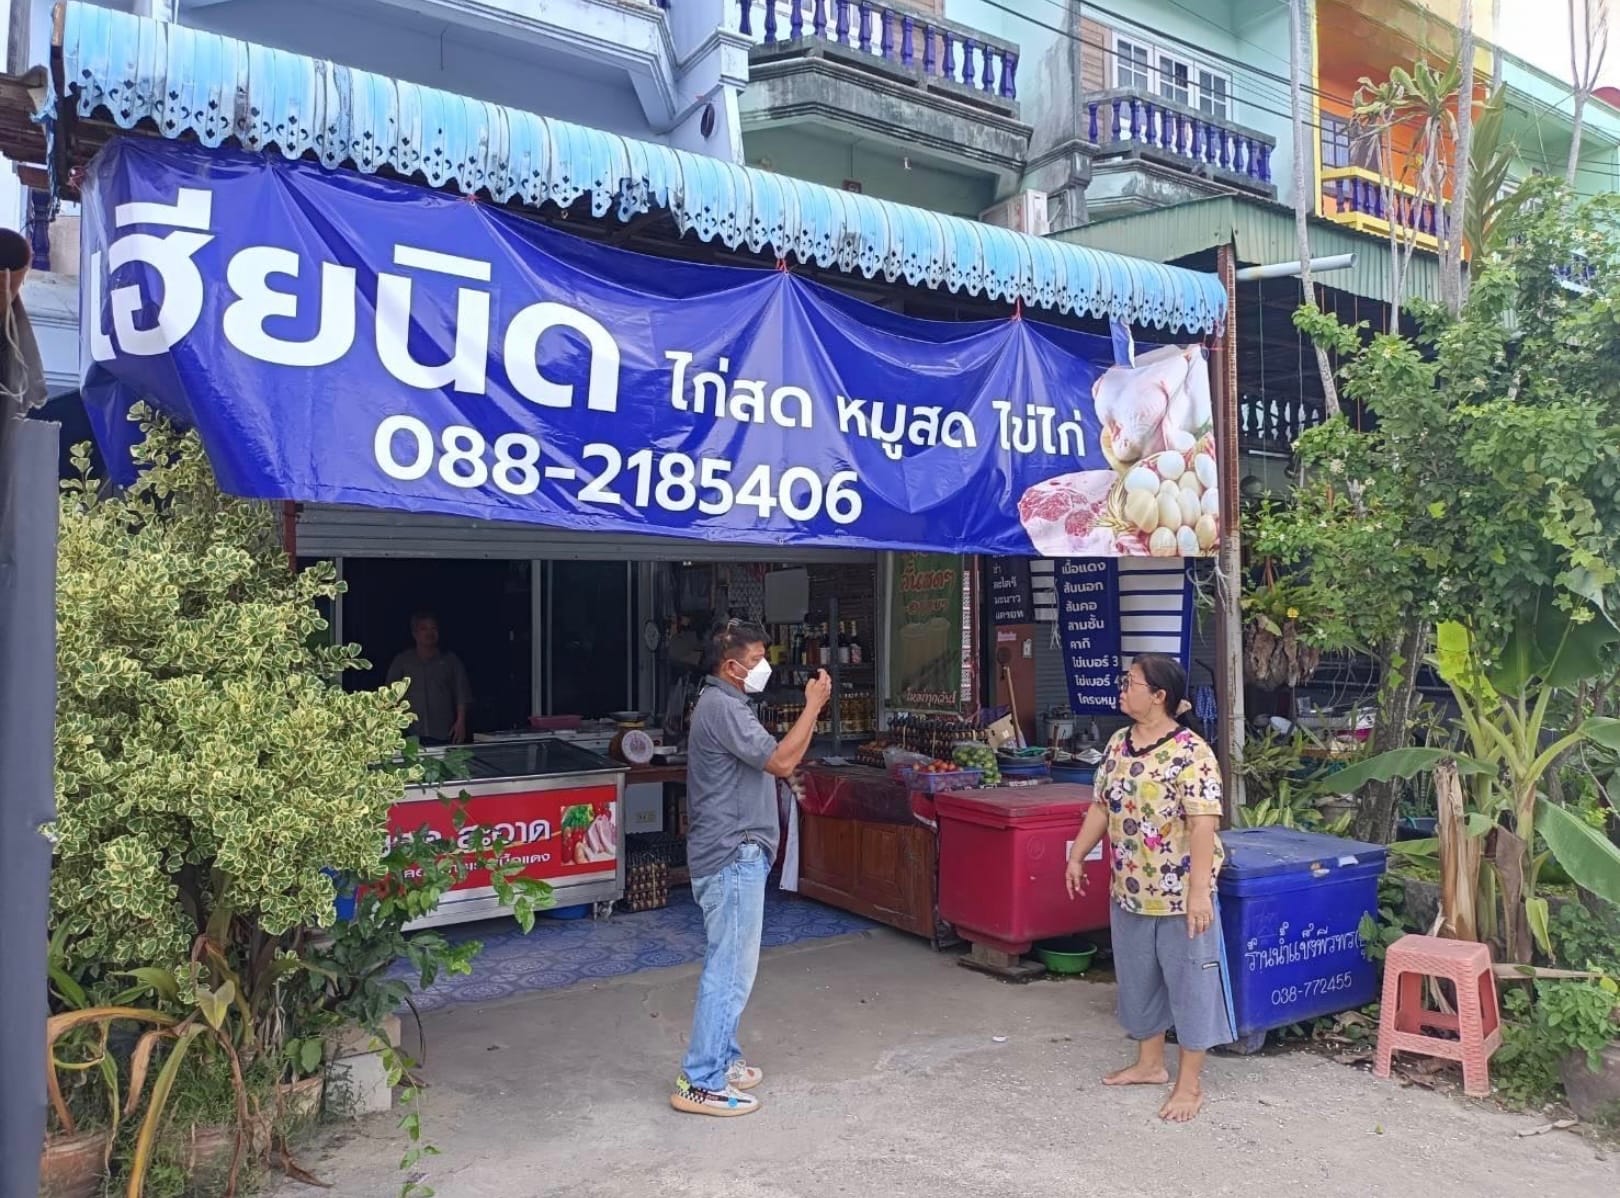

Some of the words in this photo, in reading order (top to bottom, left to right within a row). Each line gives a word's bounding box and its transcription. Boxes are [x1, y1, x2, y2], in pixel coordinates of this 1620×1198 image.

[90, 188, 620, 413] เฮียนิด
[665, 350, 813, 429] ไก่สด
[837, 394, 976, 460] หมูสด
[992, 400, 1086, 457] ไข่ไก่
[373, 414, 863, 525] 088-2185406
[1061, 559, 1106, 575] เนื้อแดง
[1063, 580, 1104, 594] สันนอก
[1065, 600, 1098, 613] สันคอ
[1067, 614, 1104, 631] สามชั้น
[1072, 655, 1110, 669] ไข่เบอร์
[1112, 656, 1119, 668] 3
[1271, 971, 1352, 1006] 038-772455
